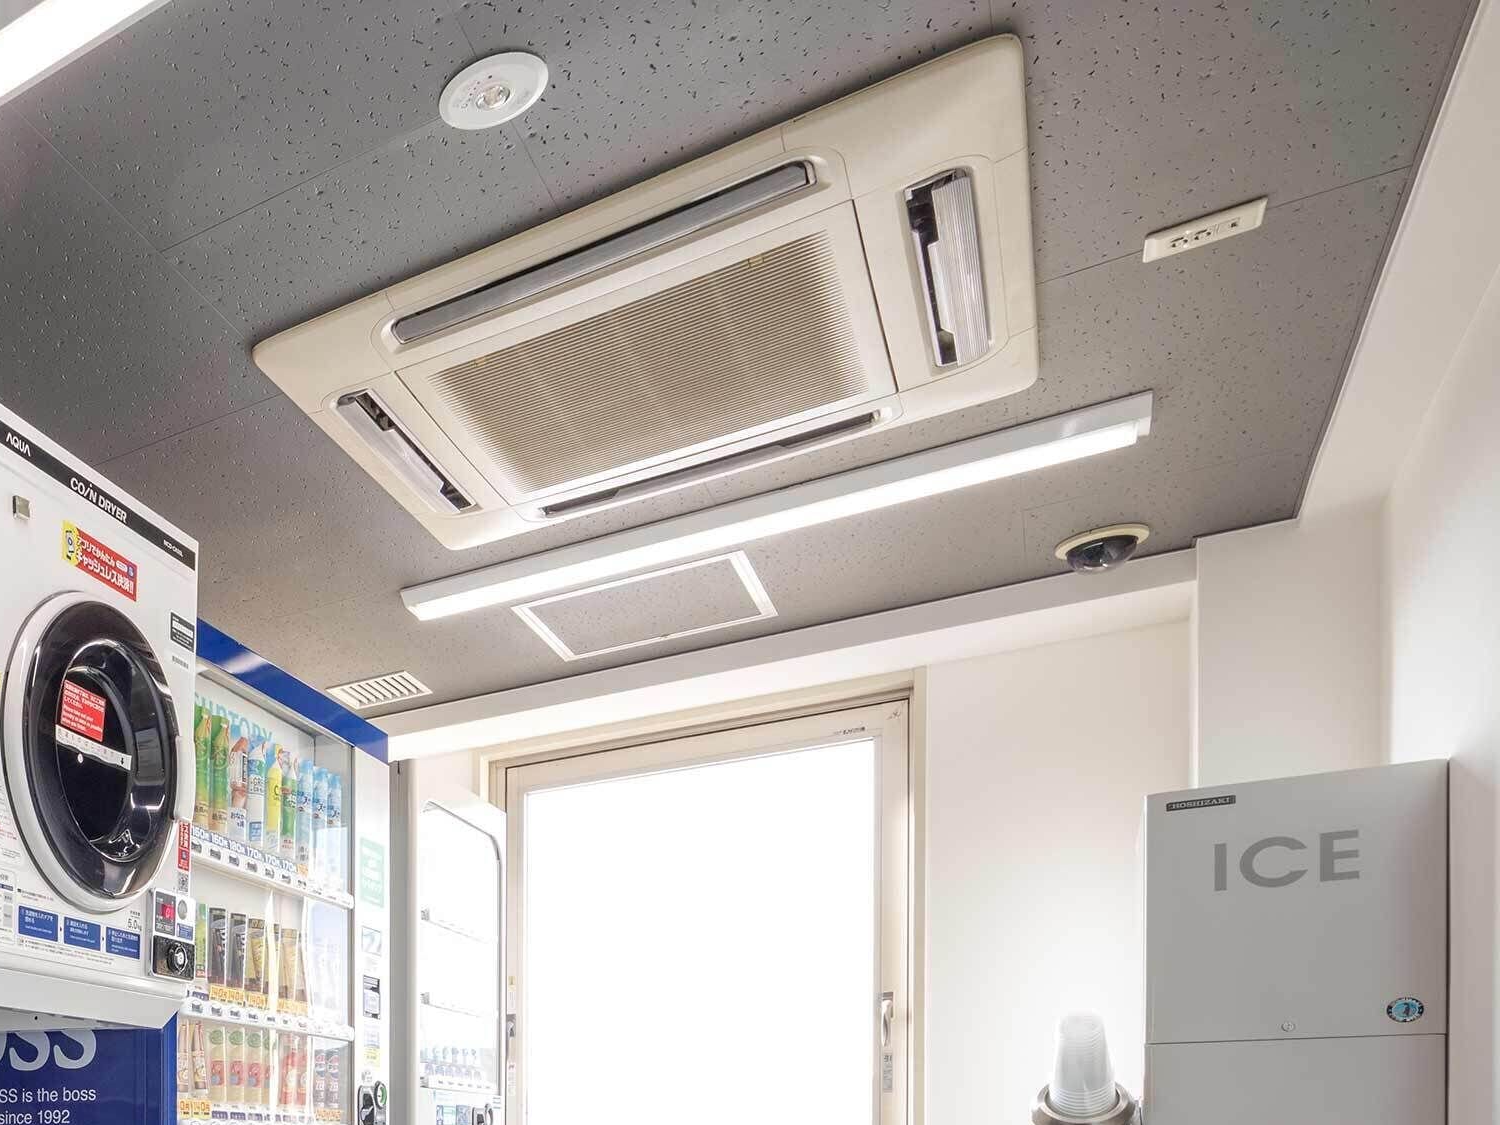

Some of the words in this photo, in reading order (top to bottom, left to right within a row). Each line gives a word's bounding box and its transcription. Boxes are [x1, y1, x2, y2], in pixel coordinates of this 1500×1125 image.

[5, 431, 32, 458] AQUA
[98, 494, 128, 524] DRYER
[1212, 829, 1361, 892] ICE
[21, 1088, 34, 1104] is
[37, 1087, 58, 1103] the
[62, 1086, 97, 1102] boss
[37, 1109, 70, 1125] 1992
